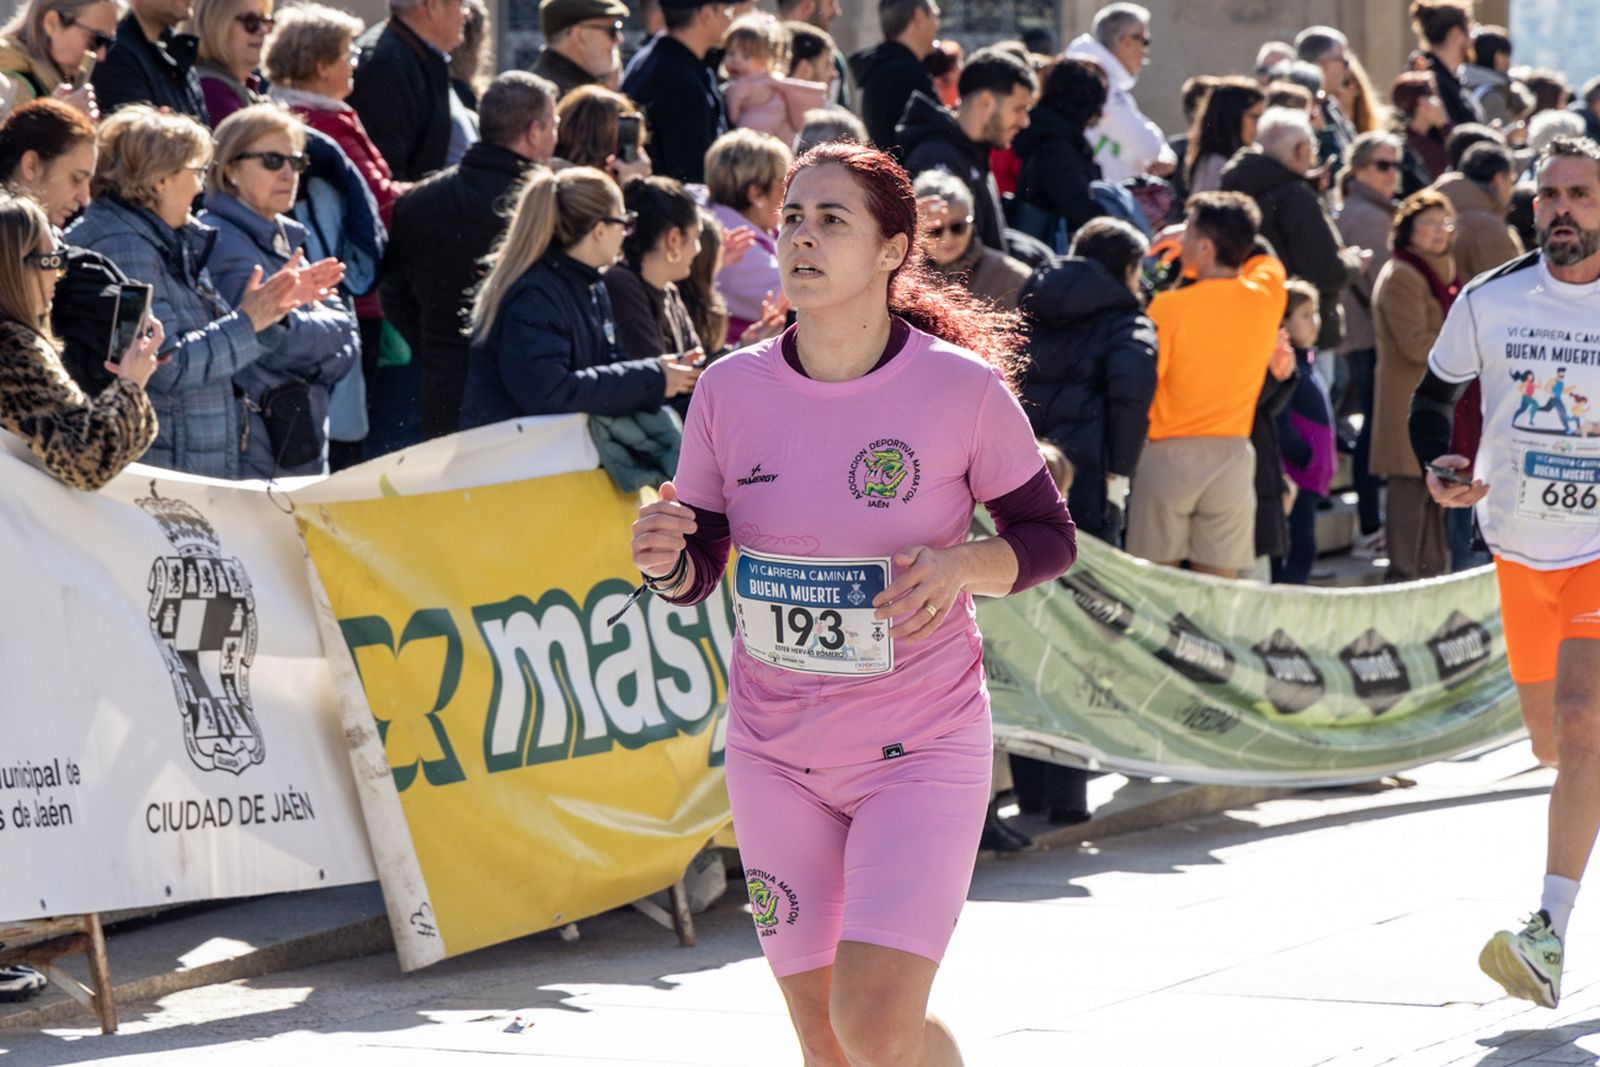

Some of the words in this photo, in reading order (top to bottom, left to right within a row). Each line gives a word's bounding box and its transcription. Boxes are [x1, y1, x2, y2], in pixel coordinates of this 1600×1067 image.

[1520, 327, 1571, 341] CARRERA
[1506, 342, 1546, 361] BUENA
[848, 448, 867, 500] ASOCIACION
[869, 438, 915, 458] DEPORTIVA
[901, 459, 920, 504] MARATON
[1542, 482, 1597, 509] 686
[750, 563, 758, 574] VI
[760, 566, 807, 580] CARRERA
[809, 569, 867, 581] CAMINATA
[750, 579, 787, 599] BUENA
[790, 585, 841, 603] MUERTE
[770, 604, 845, 650] 193
[775, 644, 790, 653] ESTER
[0, 758, 61, 795] unicipal
[66, 757, 80, 785] de
[12, 799, 31, 829] de
[33, 796, 73, 828] Jaén
[146, 797, 234, 834] CIUDAD
[239, 794, 266, 826] DE
[271, 784, 315, 824] JAÉN
[777, 881, 799, 925] MARATON
